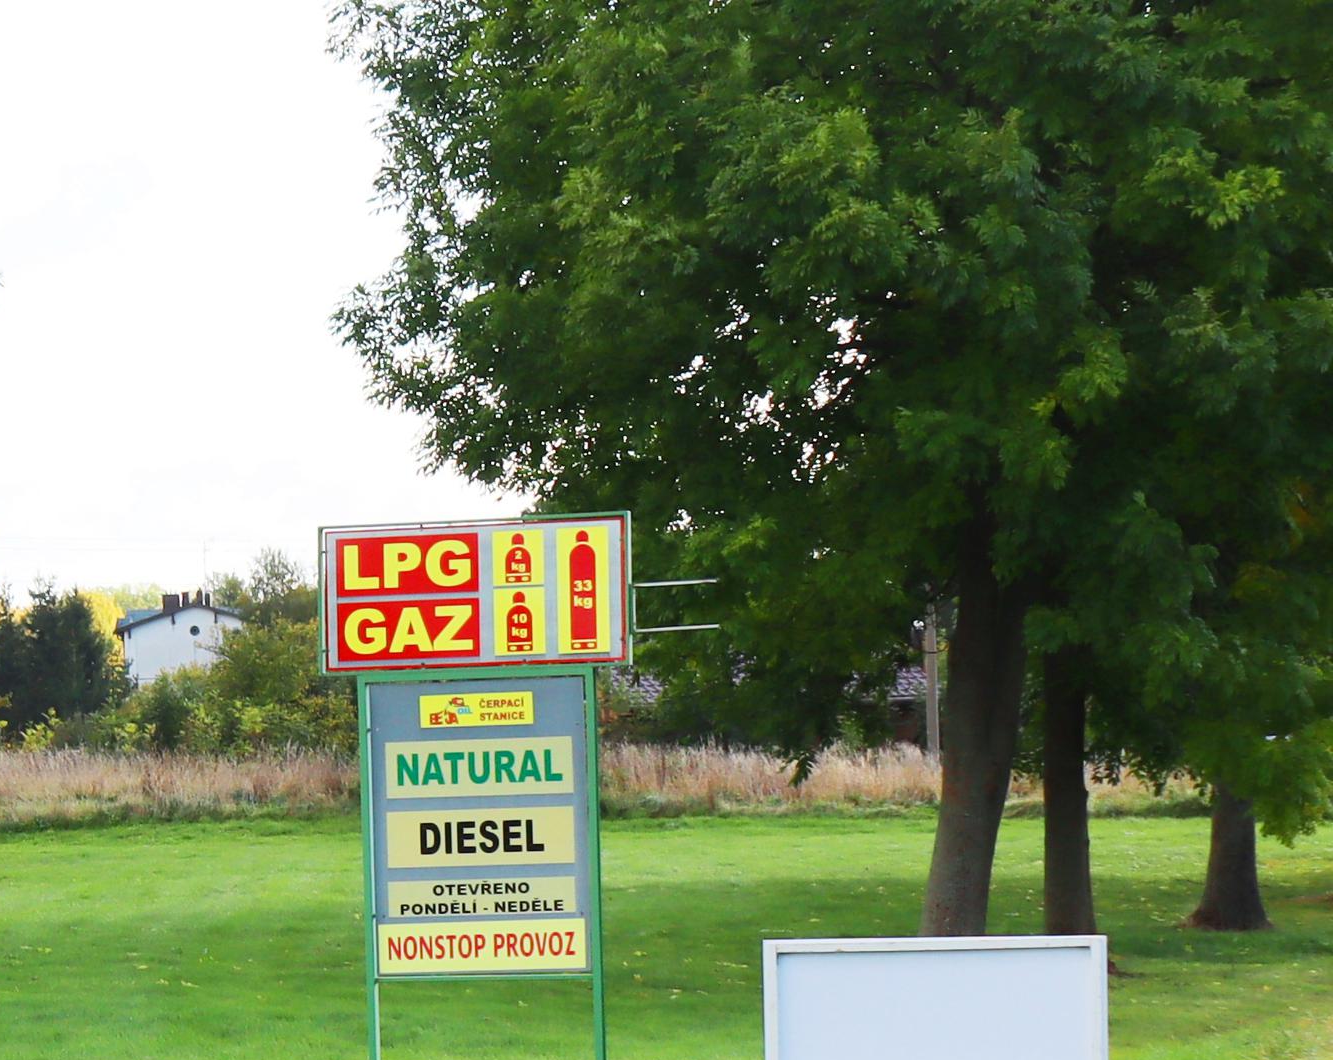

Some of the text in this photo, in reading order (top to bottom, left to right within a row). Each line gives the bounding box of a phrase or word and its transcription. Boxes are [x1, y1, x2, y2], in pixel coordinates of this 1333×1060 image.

[514, 550, 523, 560] 2
[343, 539, 472, 591] LPG
[511, 562, 526, 573] kg
[574, 579, 593, 592] 33
[573, 595, 593, 609] kg
[512, 613, 528, 624] 10
[344, 604, 474, 655] GAZ
[511, 627, 528, 638] kg
[479, 697, 525, 709] ČERPACÍ
[479, 711, 526, 721] STANICE
[396, 749, 563, 786] NATURAL
[420, 819, 545, 855] DIESEL
[433, 881, 530, 896] OTEVŘENO
[400, 899, 477, 915] PONDĚLÍ
[494, 898, 564, 913] NEDĚLE
[388, 931, 576, 960] NONSTOP PROVOZ
